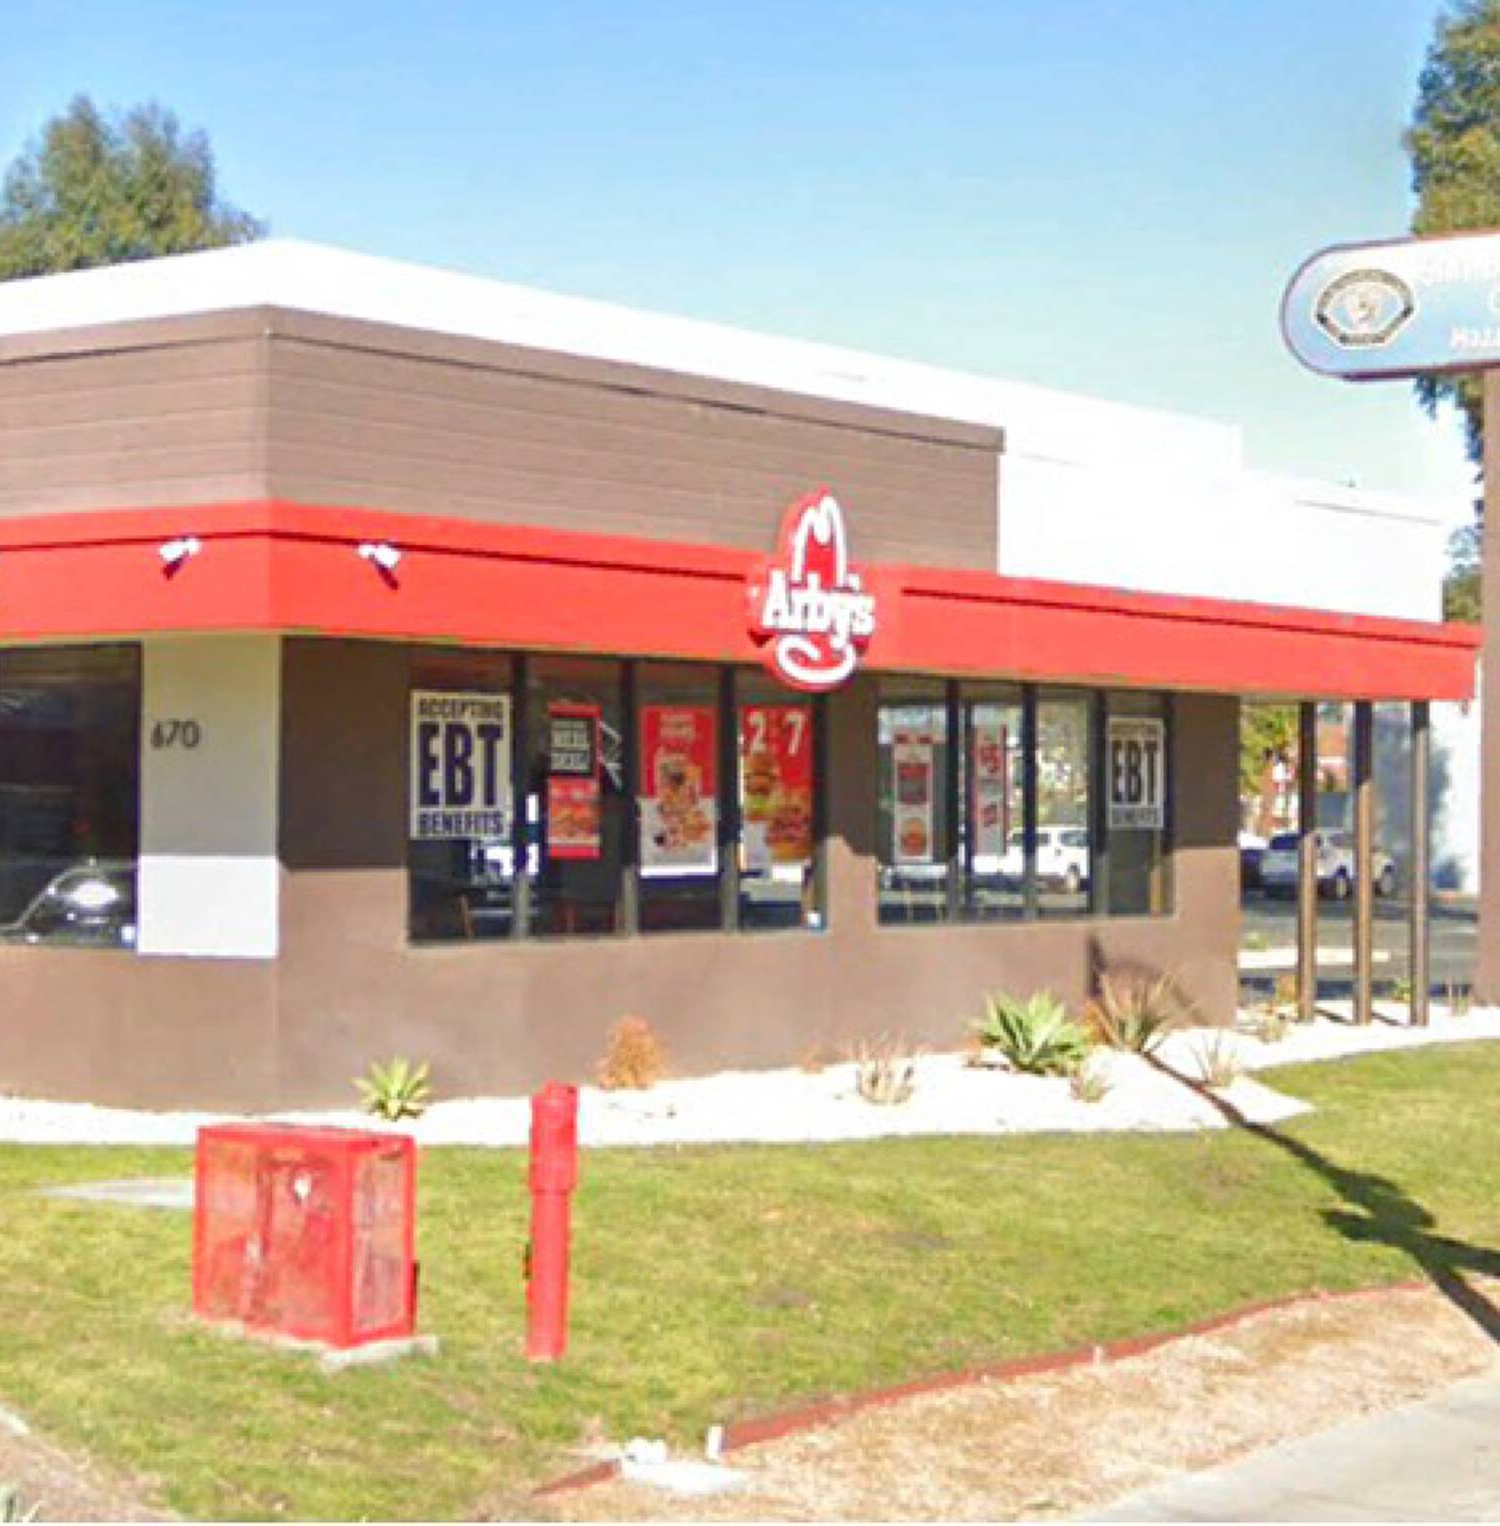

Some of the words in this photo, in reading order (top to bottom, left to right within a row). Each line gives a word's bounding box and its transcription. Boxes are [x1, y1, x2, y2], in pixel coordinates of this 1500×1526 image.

[761, 569, 876, 650] Arby's
[150, 718, 201, 749] 670
[418, 722, 504, 807] EBT
[1111, 739, 1159, 803] EBT
[418, 810, 504, 836] BENEFITS
